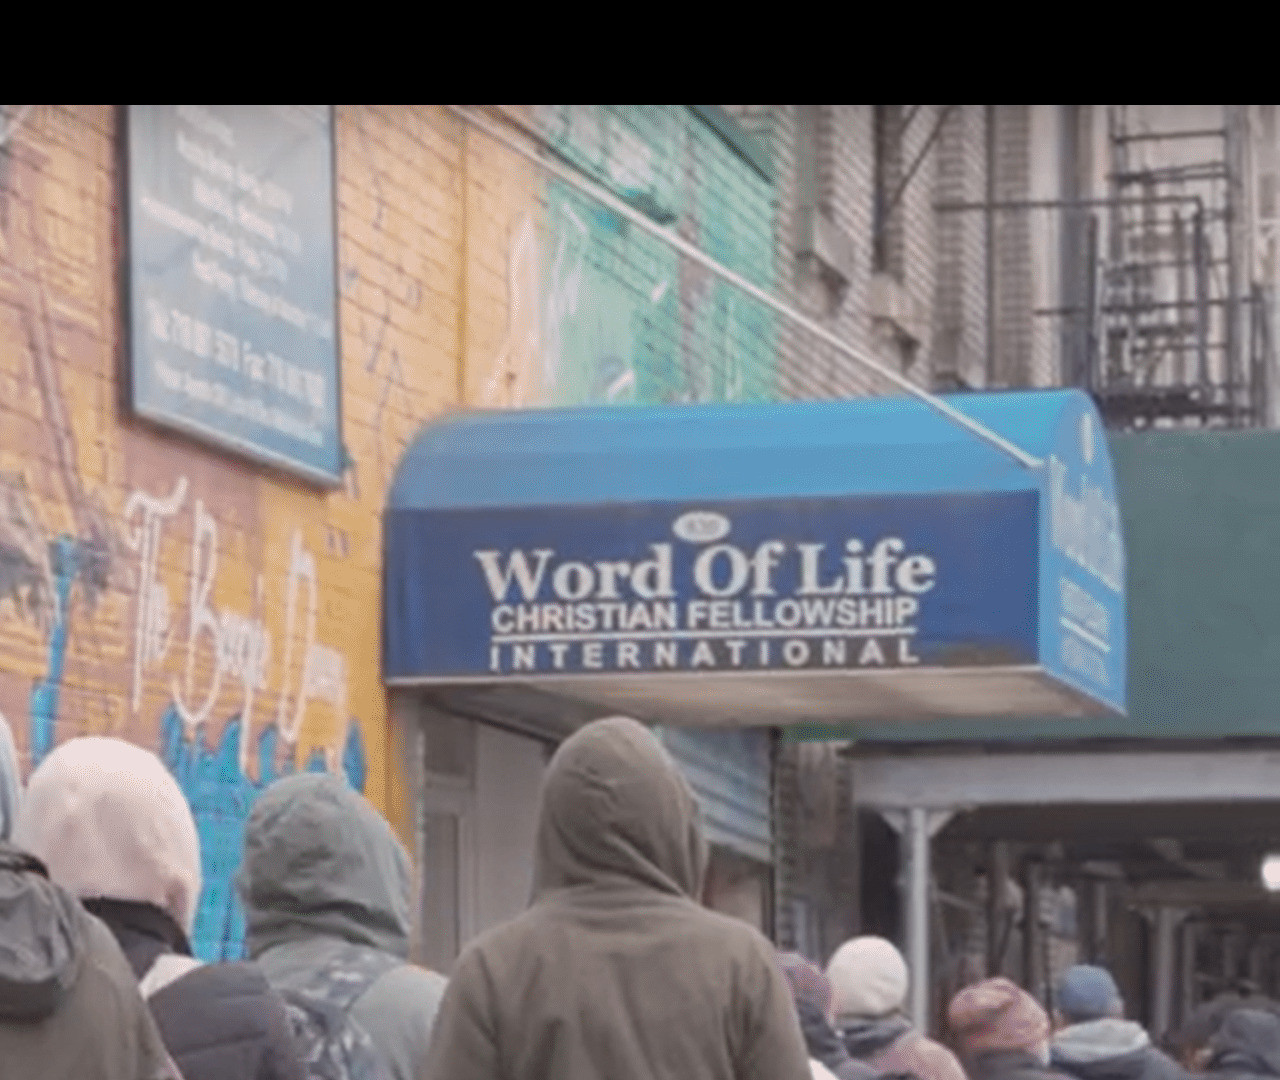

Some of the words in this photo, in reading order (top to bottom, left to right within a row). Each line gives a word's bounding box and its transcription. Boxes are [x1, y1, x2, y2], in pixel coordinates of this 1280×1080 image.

[474, 542, 678, 601] Word
[694, 540, 785, 597] Of
[795, 537, 937, 594] Life
[491, 600, 678, 634] CHRISTIAN
[687, 596, 919, 629] FELLOWSHIP
[489, 638, 920, 672] INTERNATIONAL
